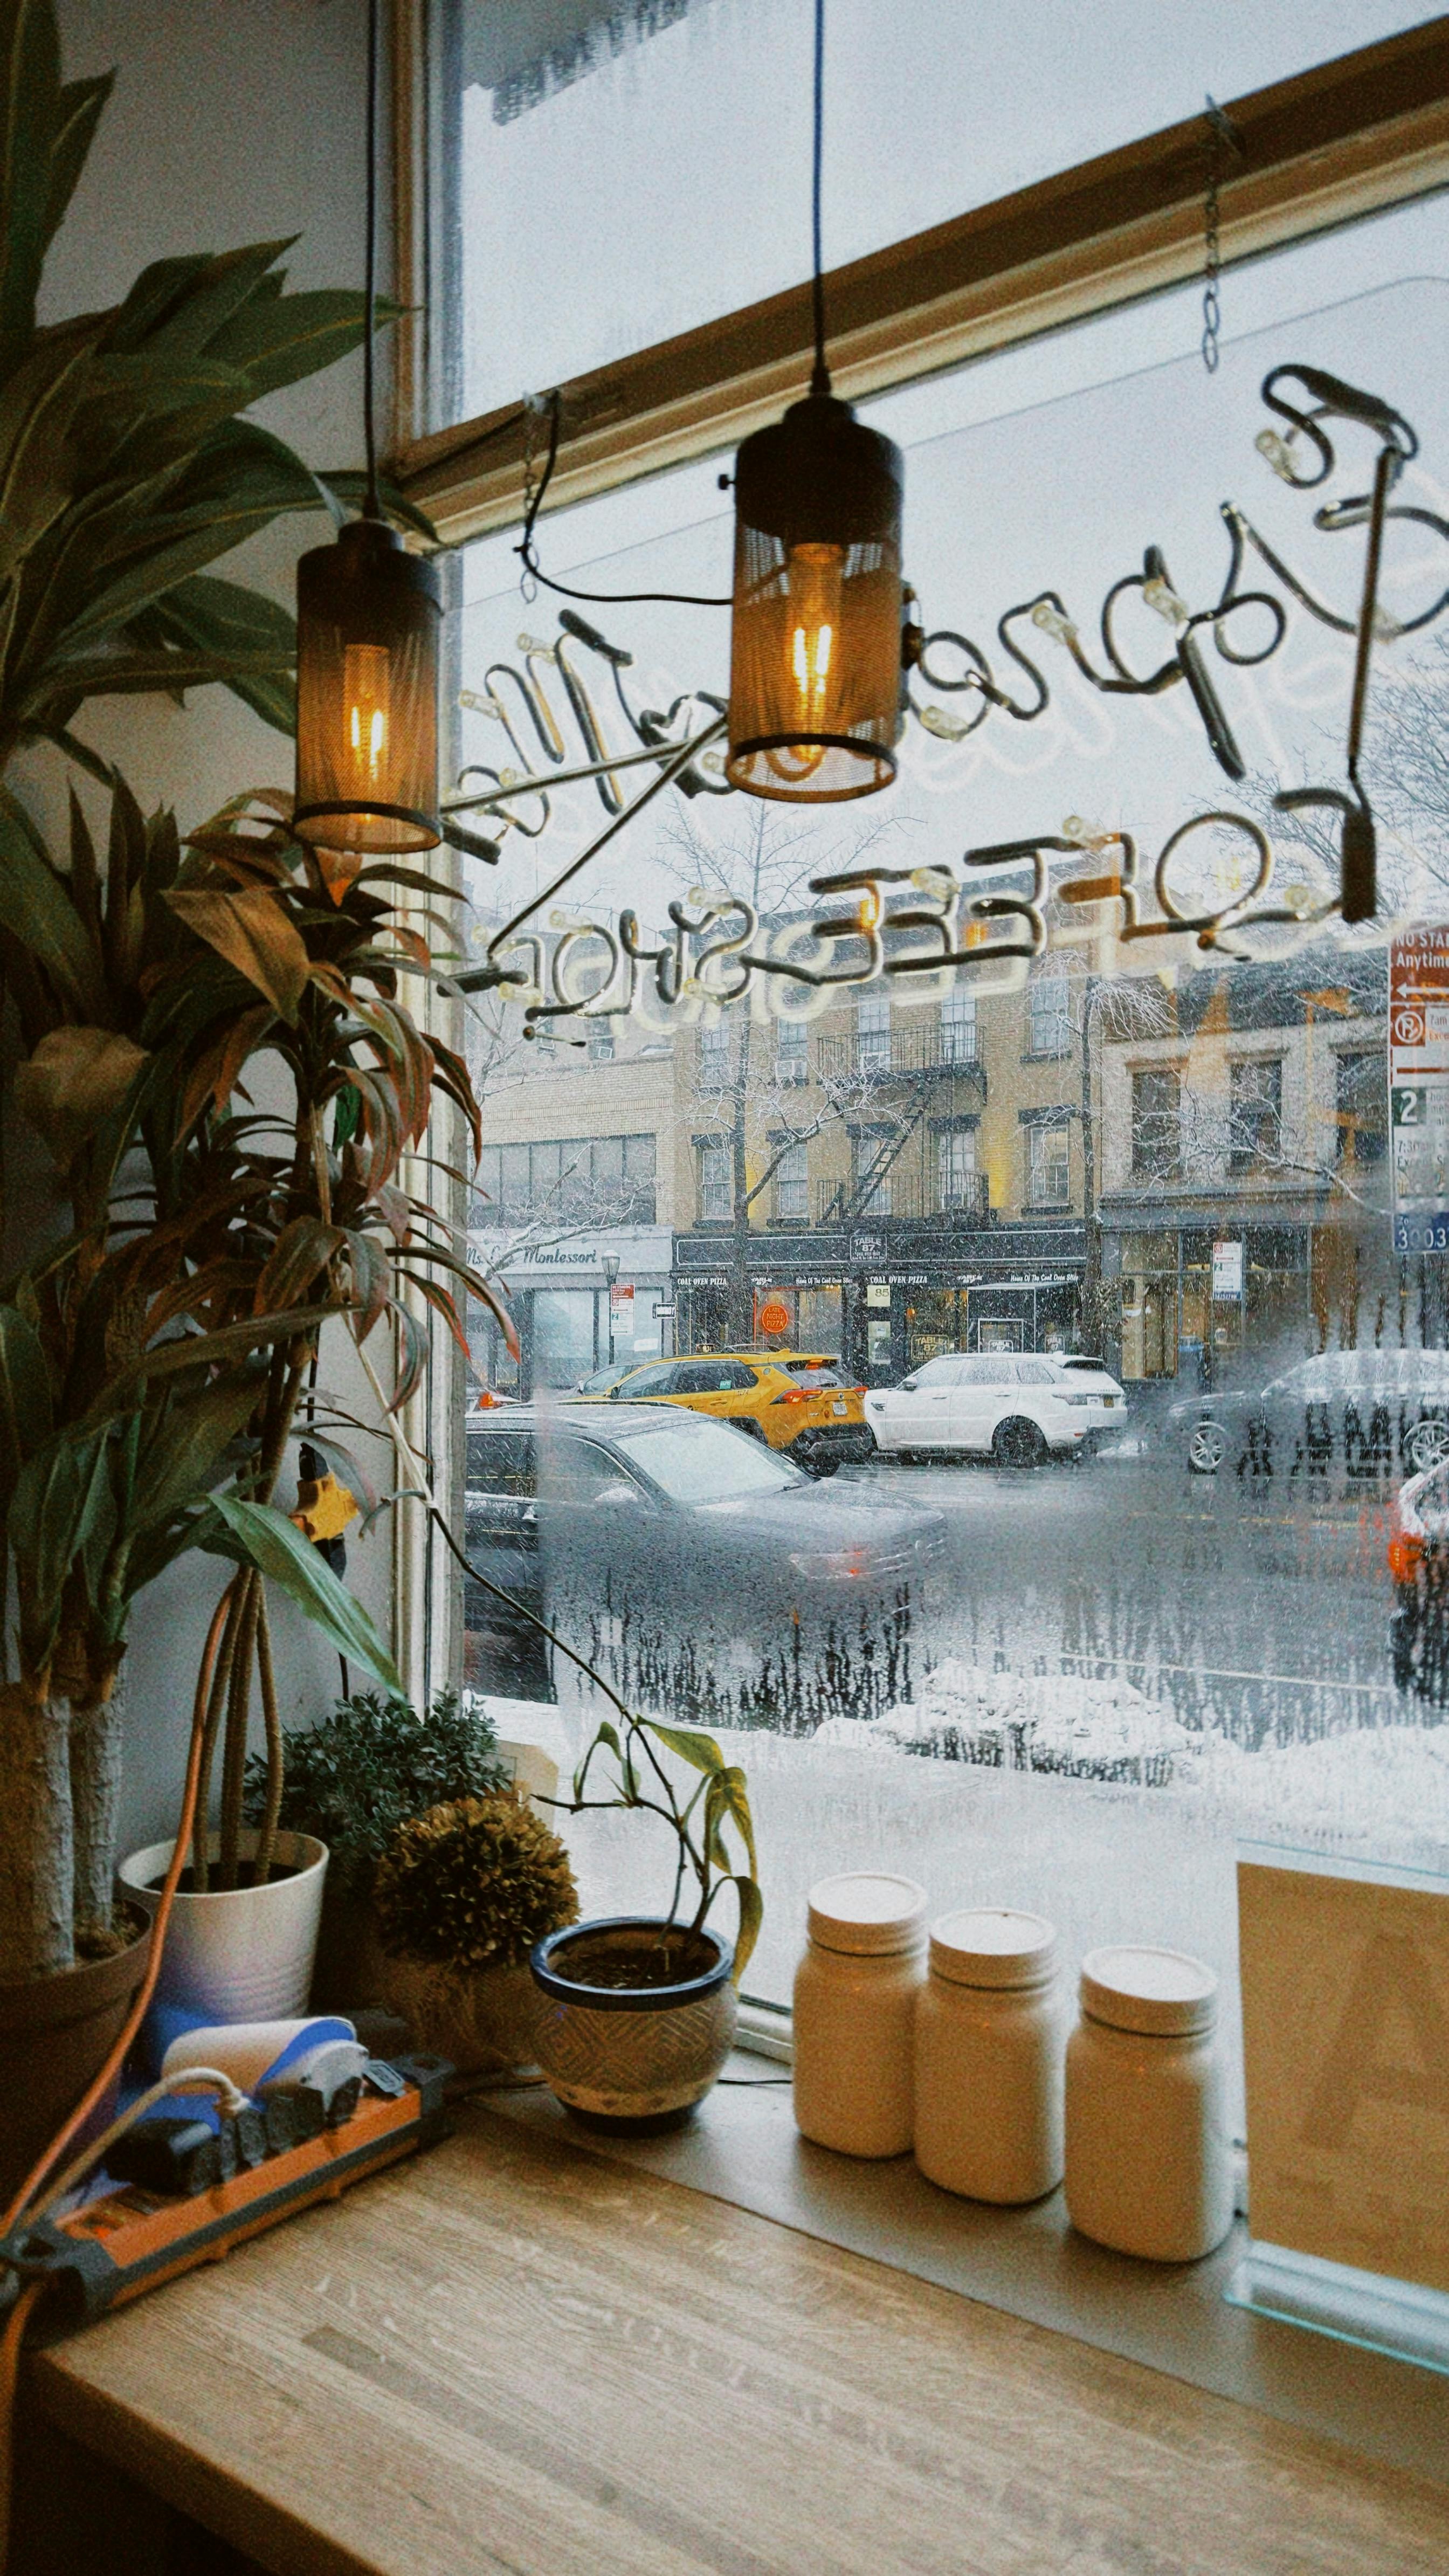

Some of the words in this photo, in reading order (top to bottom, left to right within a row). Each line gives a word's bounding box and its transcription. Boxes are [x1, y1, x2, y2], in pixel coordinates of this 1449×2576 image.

[1396, 933, 1414, 947] NO
[1420, 932, 1449, 947] STA
[1400, 1090, 1417, 1124] 2
[854, 1237, 882, 1246] TABLE
[523, 1245, 598, 1264] Montessori
[870, 1276, 887, 1284] COAL
[888, 1276, 906, 1284] OVEN
[908, 1276, 928, 1284] PIZZA
[1024, 1274, 1030, 1282] Of
[875, 1288, 889, 1297] 85
[915, 1337, 944, 1346] TABLE
